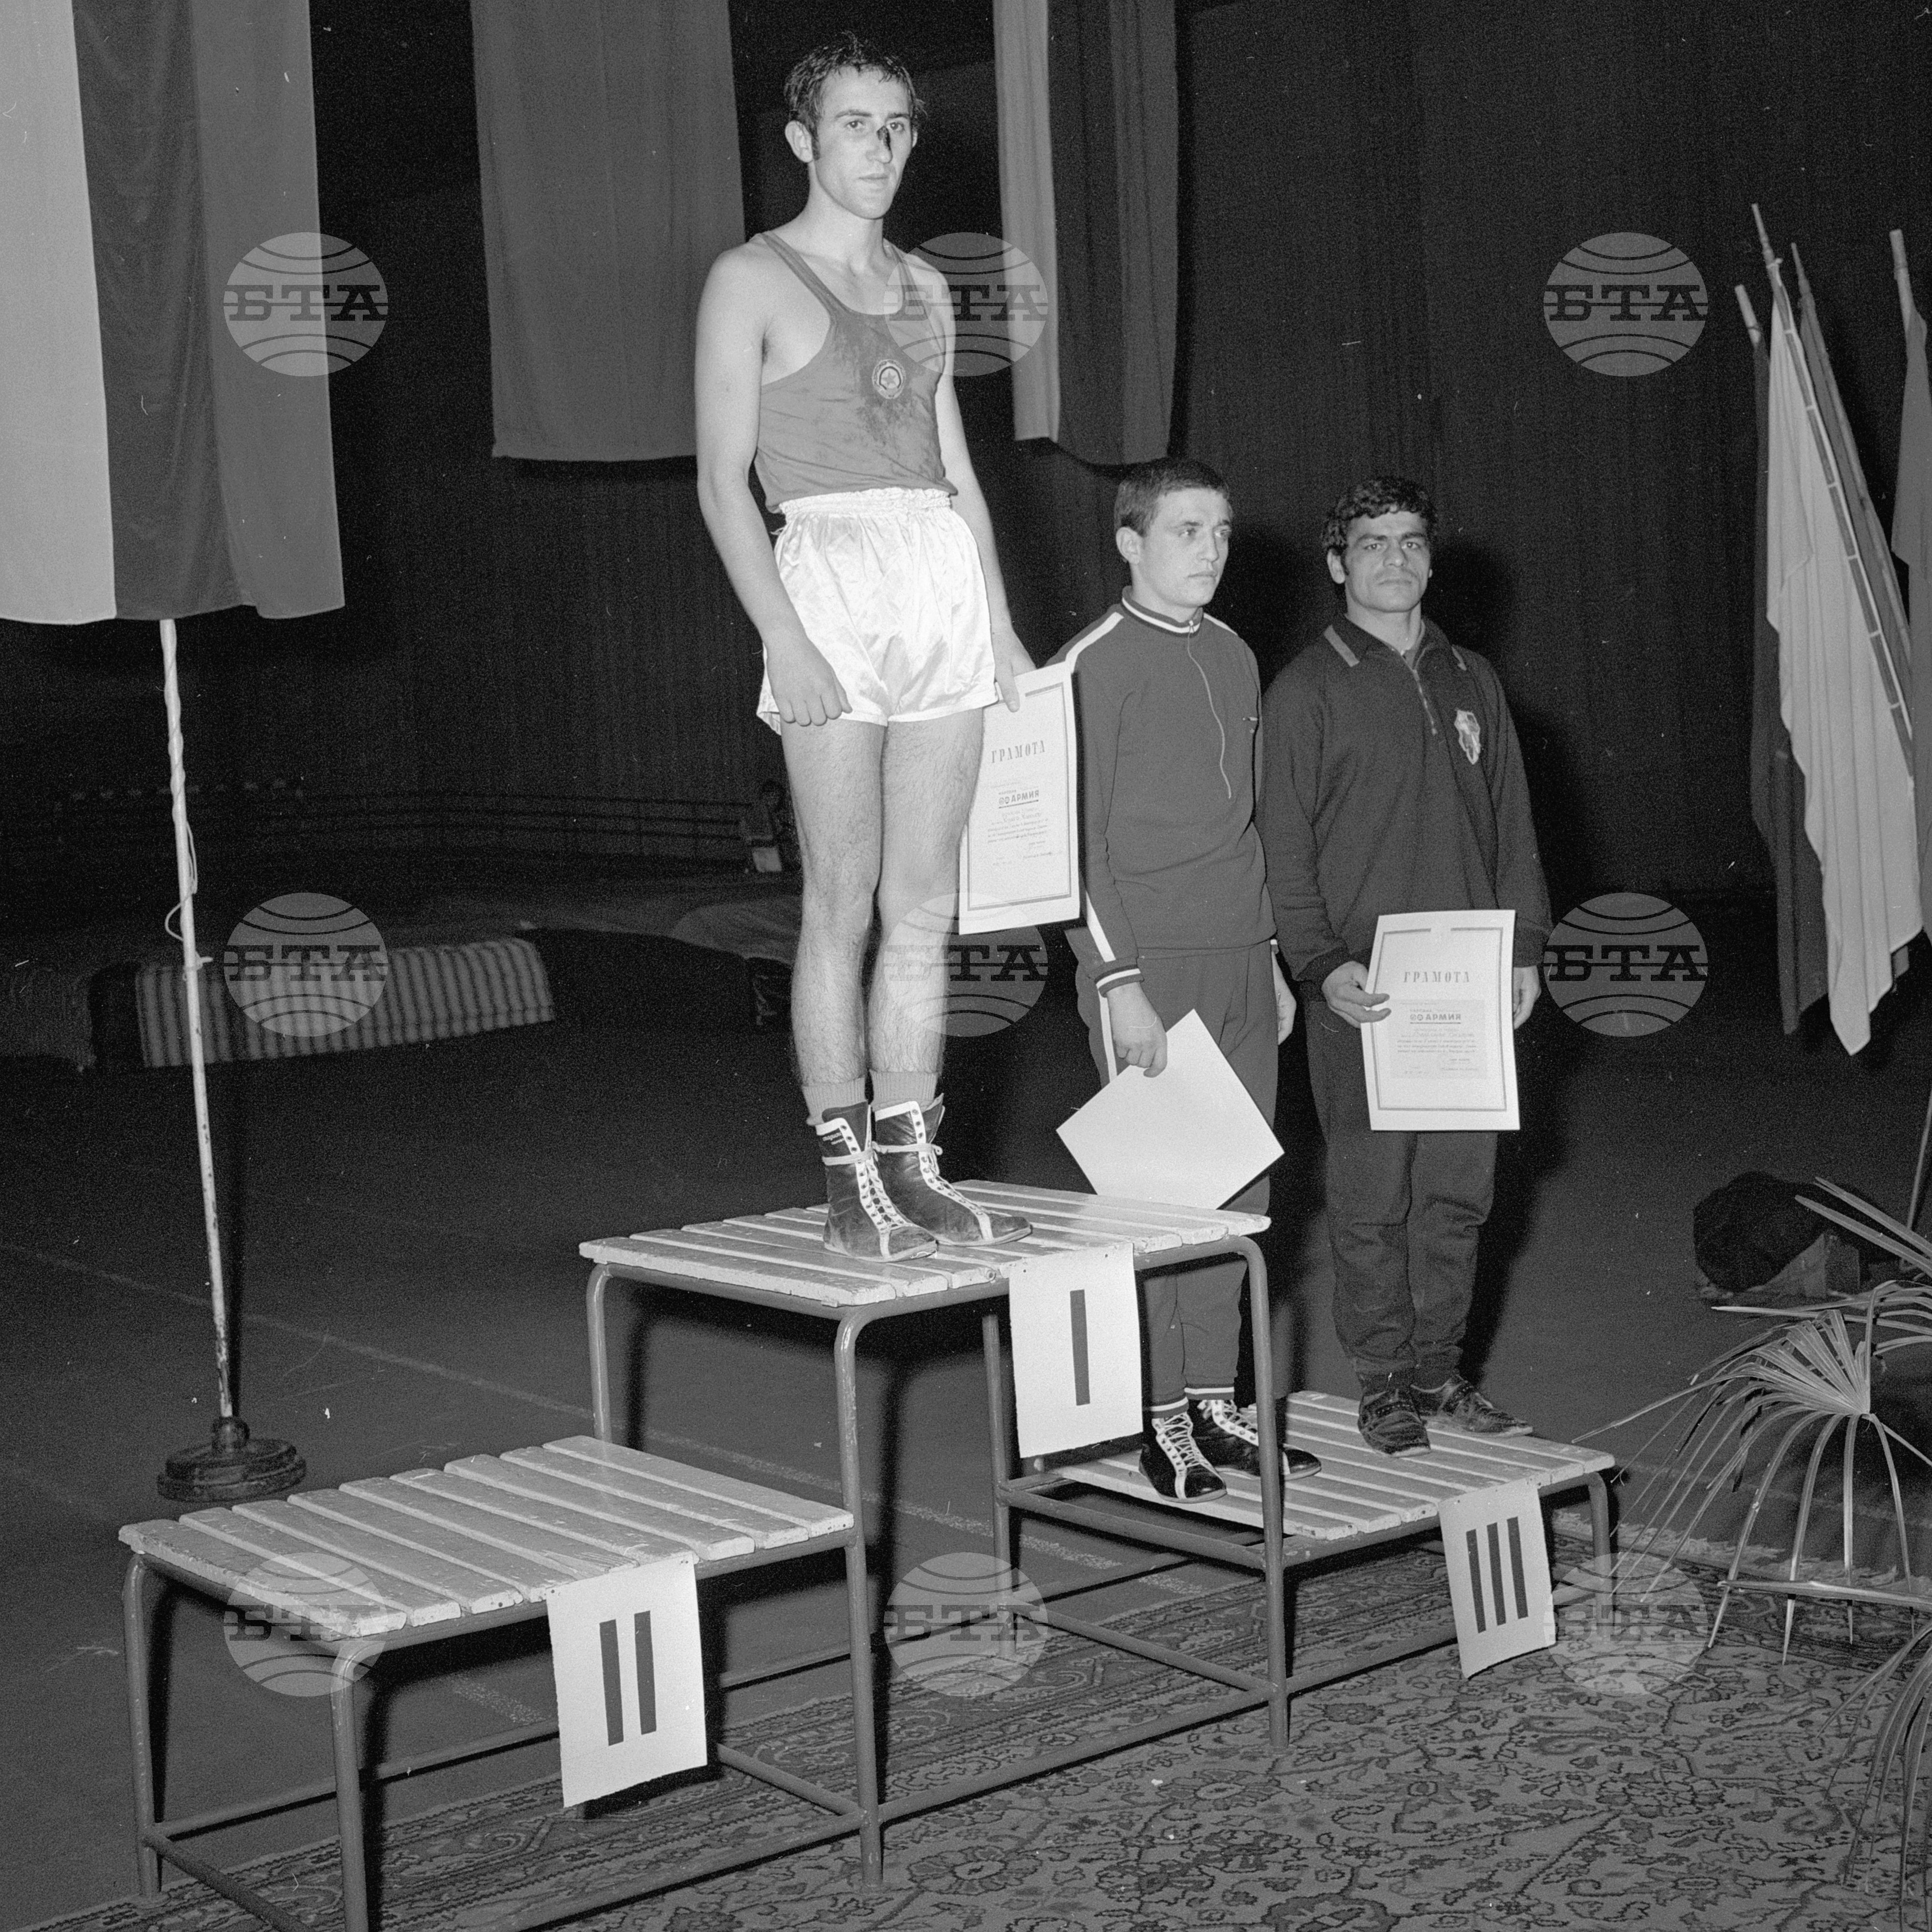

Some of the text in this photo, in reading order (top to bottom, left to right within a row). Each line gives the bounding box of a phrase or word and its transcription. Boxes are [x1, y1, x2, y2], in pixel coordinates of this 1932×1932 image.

[991, 740, 1045, 764] ГРАМОТА
[1011, 789, 1039, 803] АРМИЯ
[1403, 971, 1470, 983] ГРАМОТА
[1466, 1516, 1529, 1634] III
[599, 1610, 657, 1746] II
